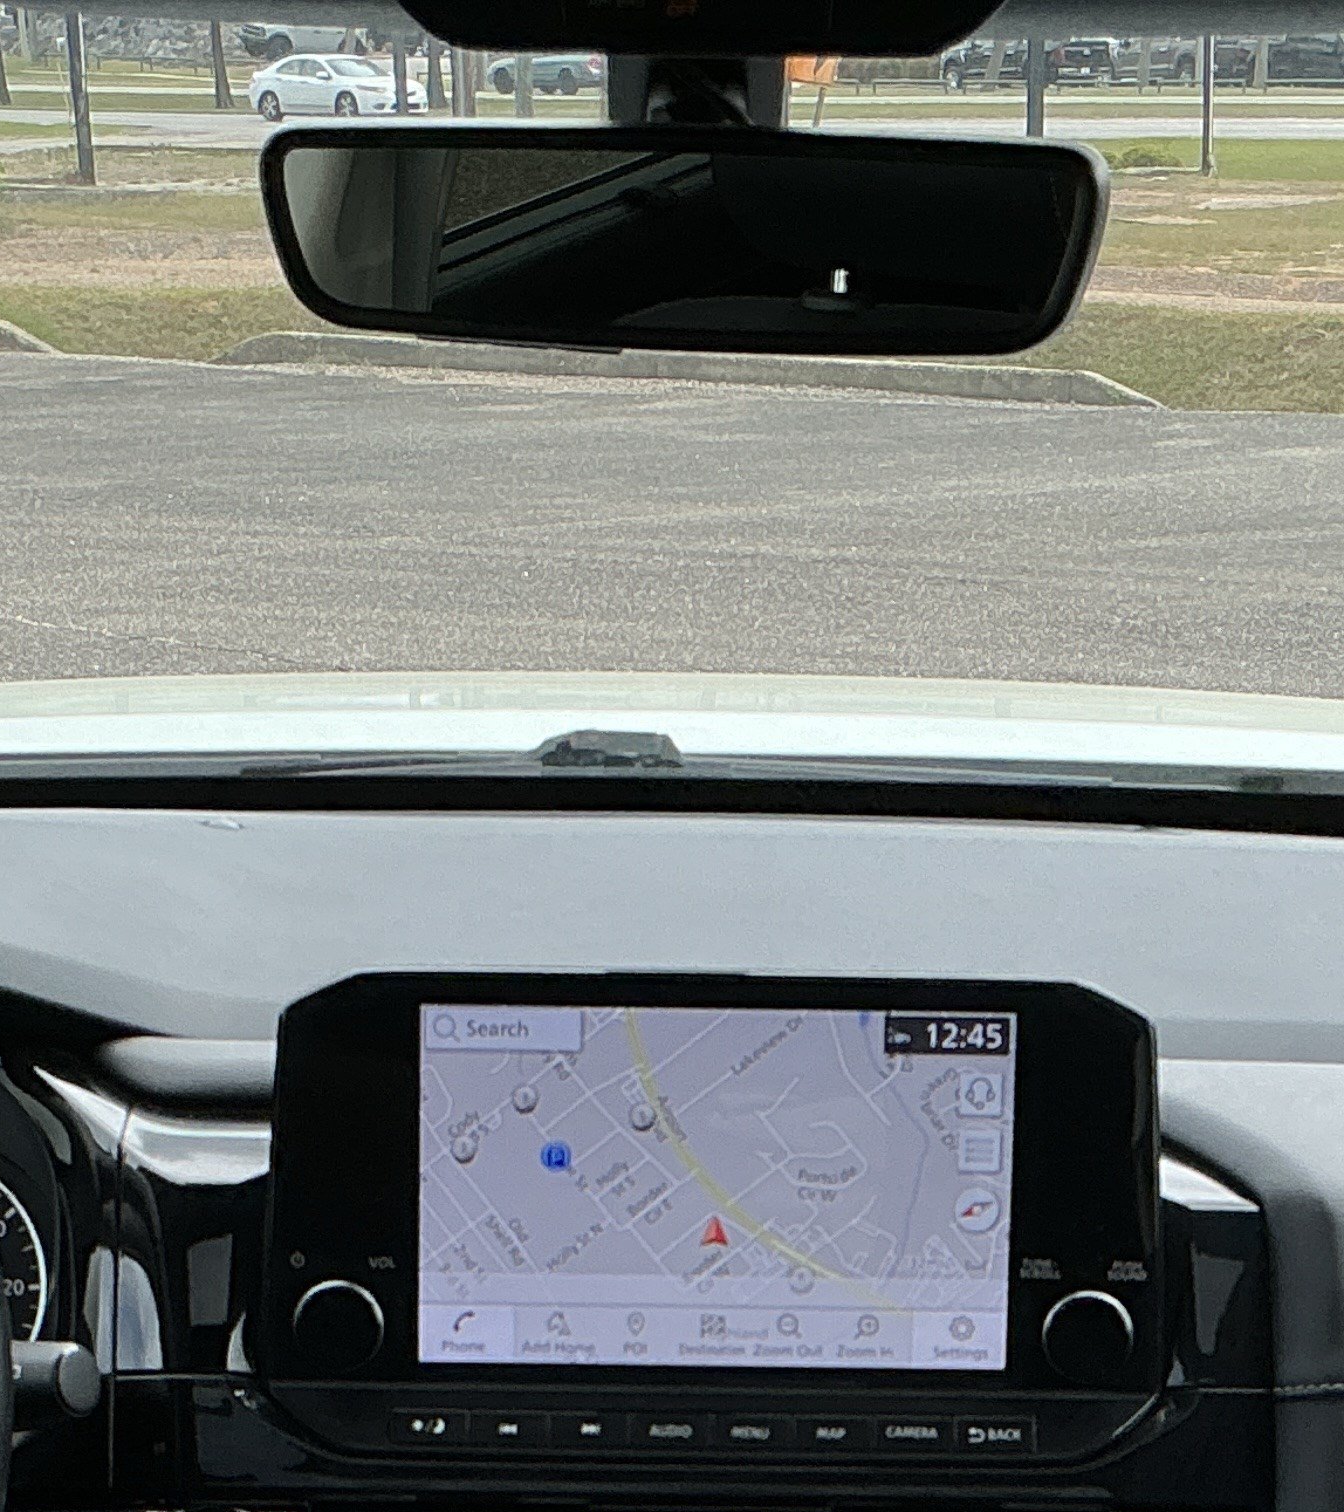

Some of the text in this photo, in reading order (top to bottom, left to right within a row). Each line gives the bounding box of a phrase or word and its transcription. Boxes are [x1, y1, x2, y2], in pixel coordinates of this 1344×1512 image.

[466, 1019, 530, 1039] Search
[926, 1022, 1003, 1049] 12:45
[368, 1256, 396, 1269] VOL
[441, 1340, 486, 1352] Phone
[932, 1344, 990, 1361] Settings
[648, 1423, 693, 1438] AUDIO
[815, 1426, 847, 1439] MAP
[884, 1425, 939, 1440] CAMERA
[987, 1427, 1022, 1441] BACK
